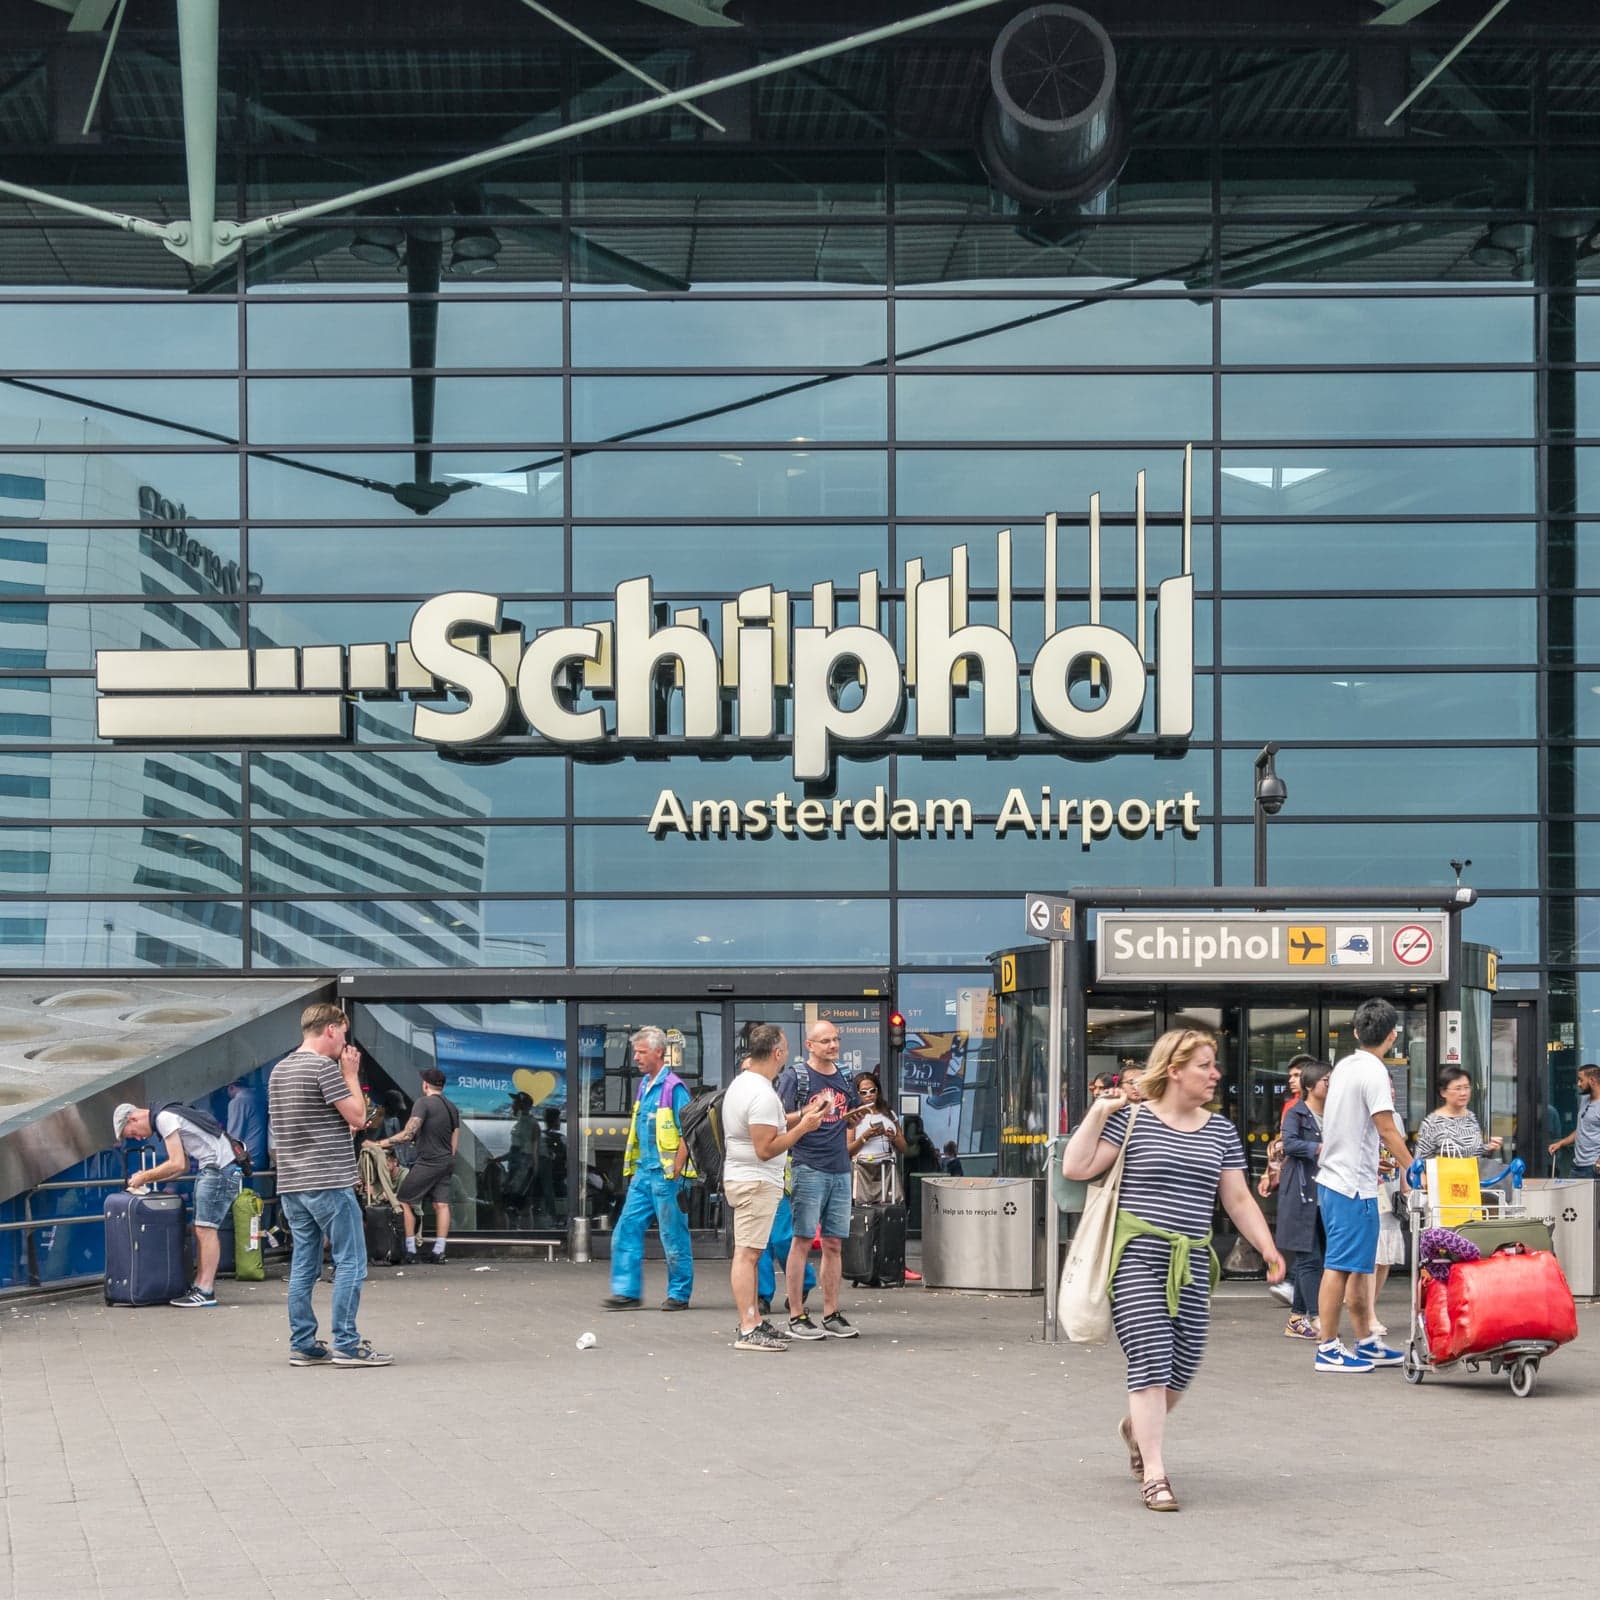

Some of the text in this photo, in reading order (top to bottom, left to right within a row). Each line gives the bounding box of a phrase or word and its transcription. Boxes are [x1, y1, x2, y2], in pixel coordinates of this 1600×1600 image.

[410, 574, 1194, 780] Schiphol
[647, 785, 1200, 845] Amsterdam Airport
[1113, 926, 1280, 968] Schiphol
[1004, 961, 1012, 987] D
[1489, 958, 1496, 984] D
[833, 1008, 859, 1017] Hotels
[942, 1208, 956, 1217] Help
[974, 1208, 998, 1217] recycle
